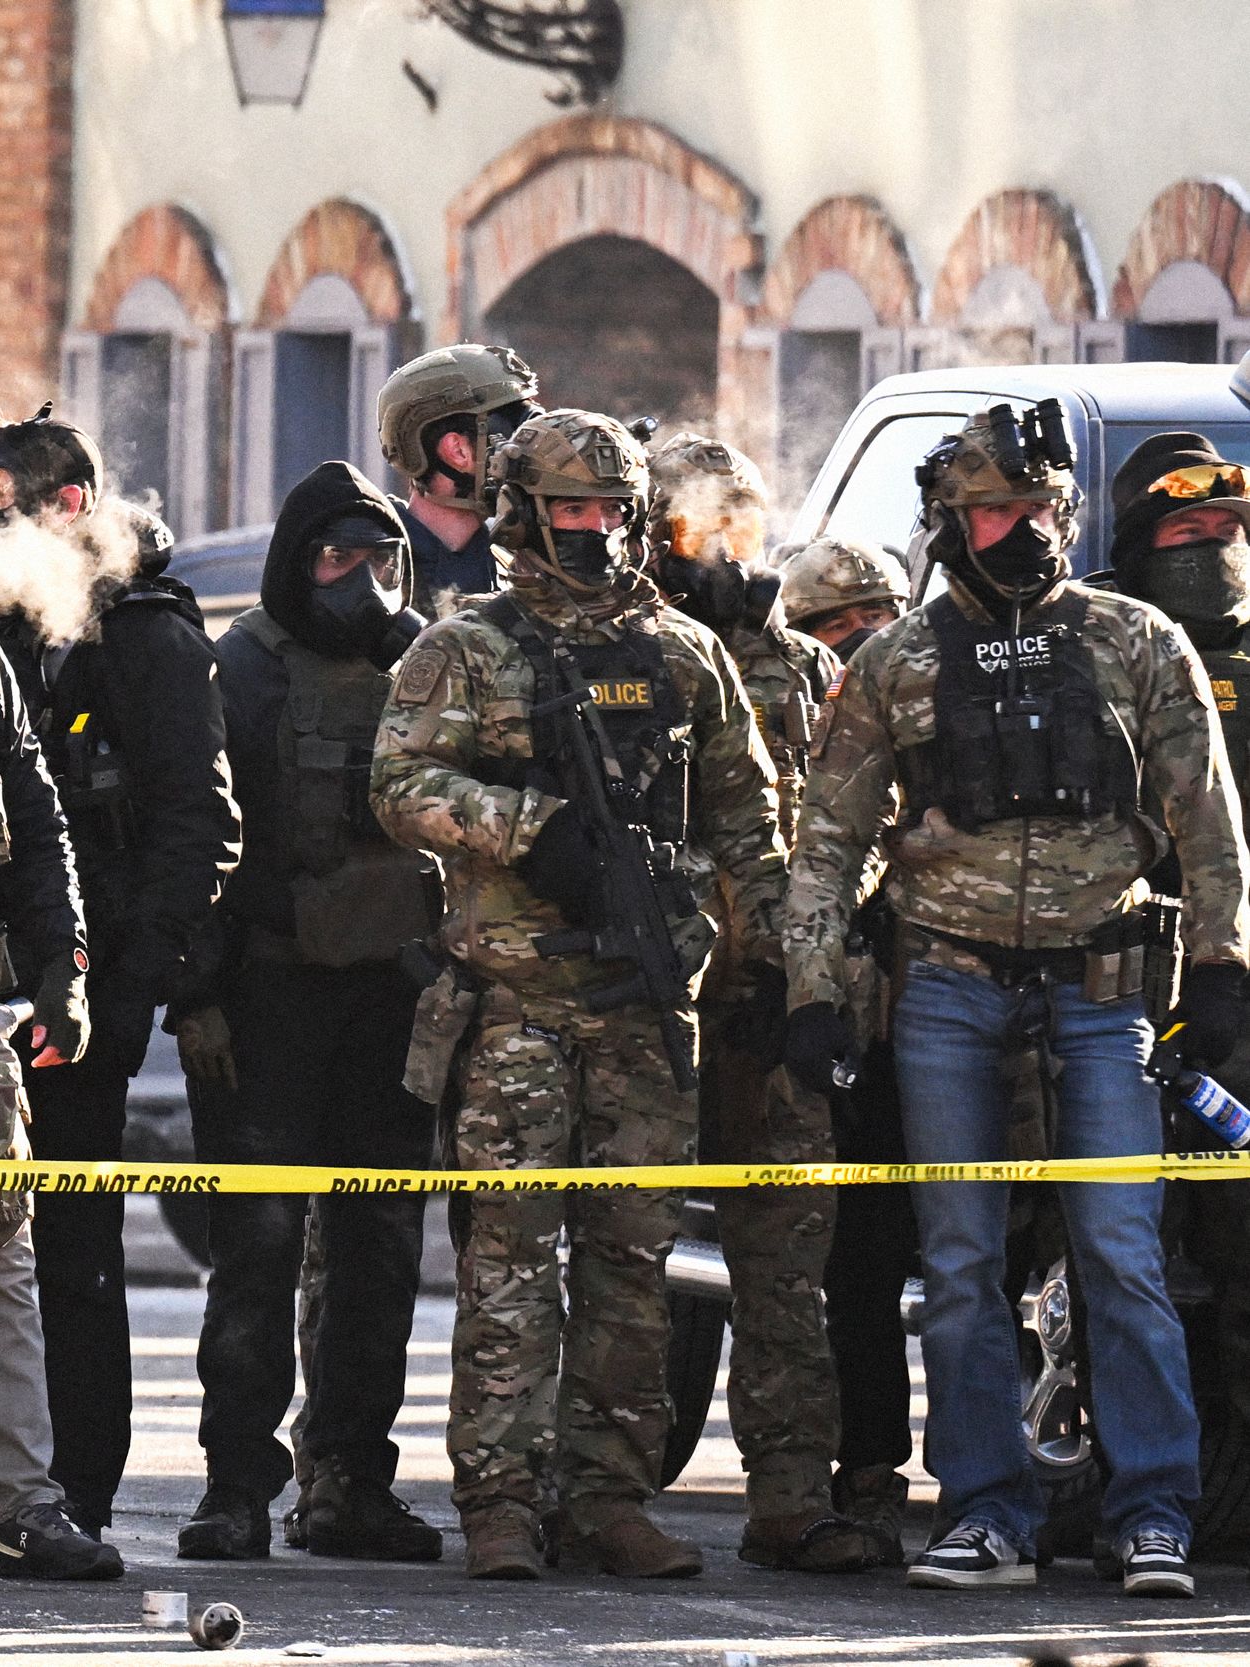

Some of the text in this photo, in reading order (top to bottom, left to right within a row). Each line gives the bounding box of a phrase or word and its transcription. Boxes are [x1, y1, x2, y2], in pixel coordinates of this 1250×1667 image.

[976, 635, 1050, 659] POLICE
[591, 682, 649, 704] OLICE
[54, 1173, 87, 1192] DO
[94, 1174, 141, 1192] NOT
[144, 1175, 221, 1192] CROSS
